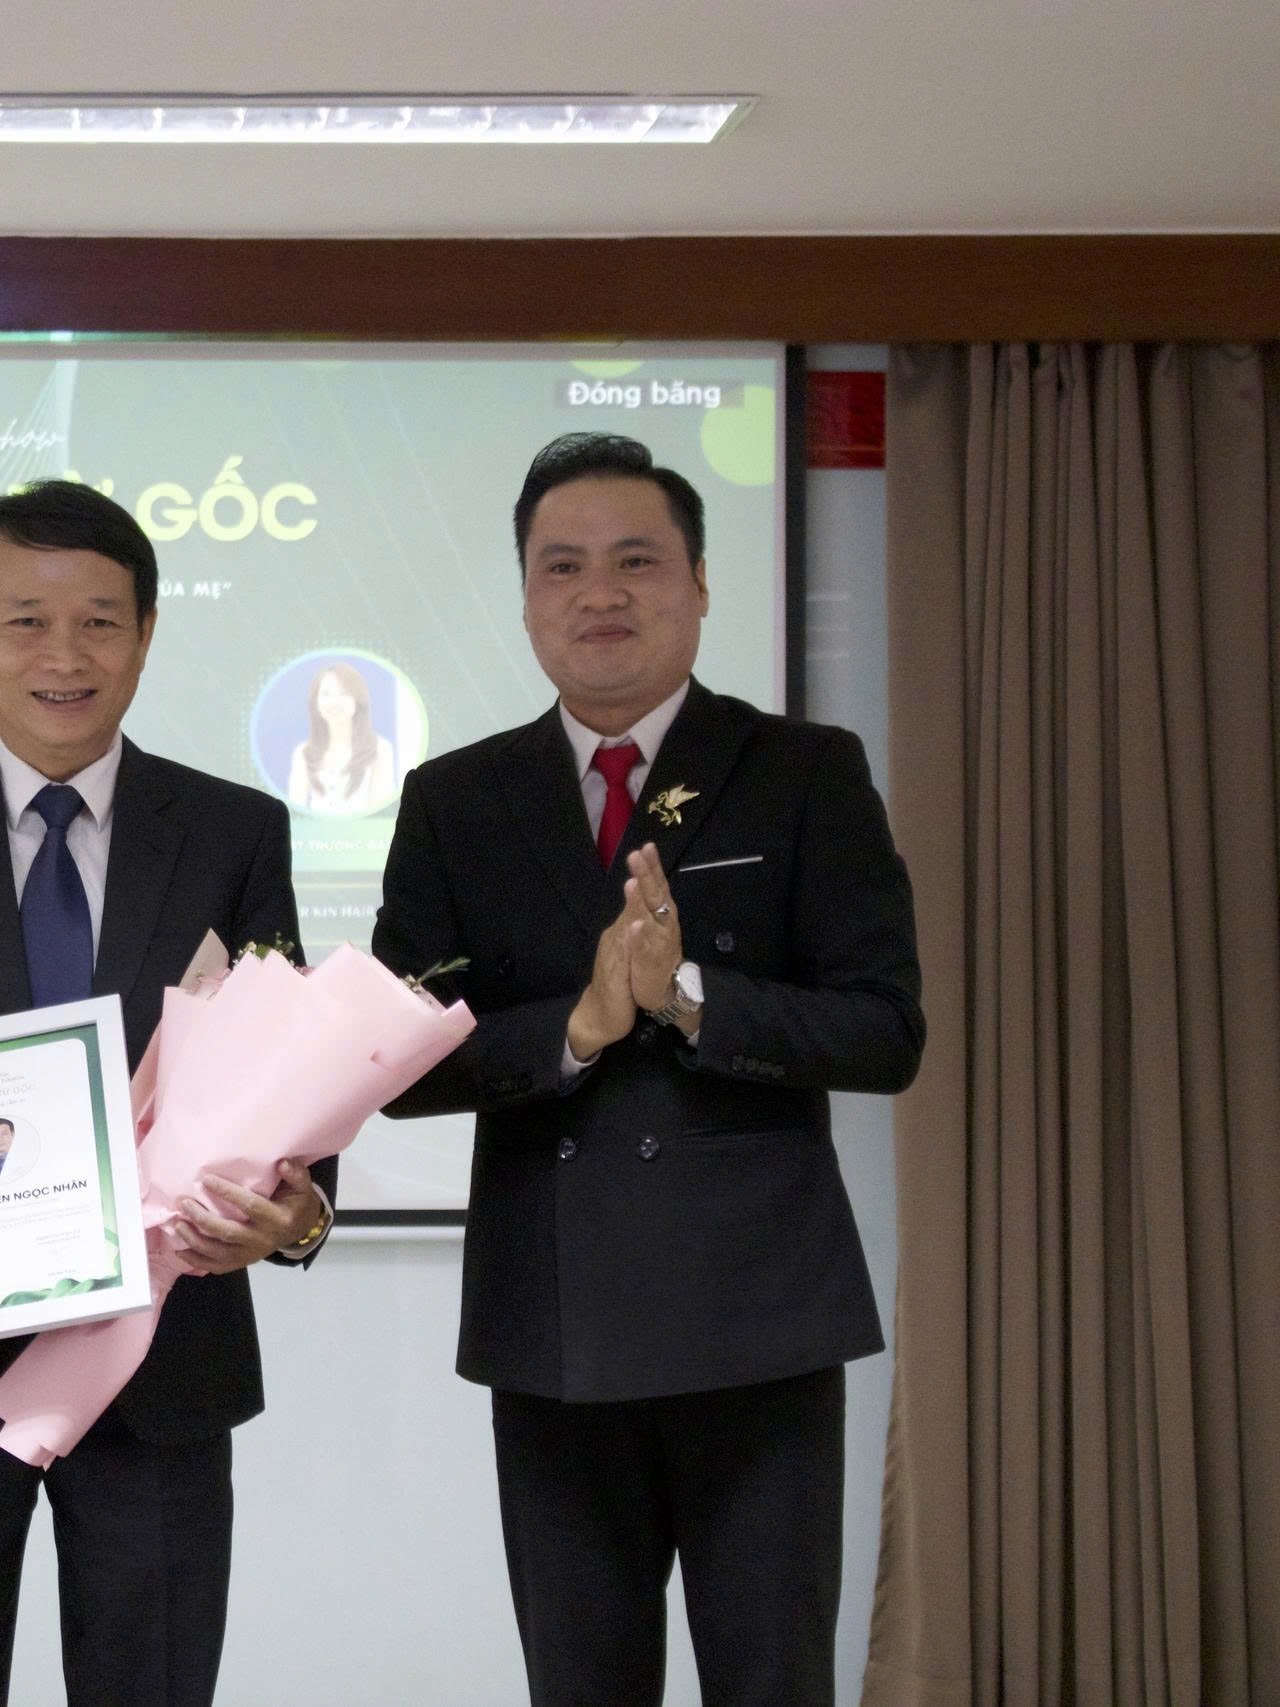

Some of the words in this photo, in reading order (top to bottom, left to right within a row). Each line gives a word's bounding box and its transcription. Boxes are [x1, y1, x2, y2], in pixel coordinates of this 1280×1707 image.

[568, 380, 641, 408] Đóng
[135, 455, 319, 542] GỐC
[13, 1186, 50, 1201] NGỌC
[53, 1179, 88, 1195] NHÂN
